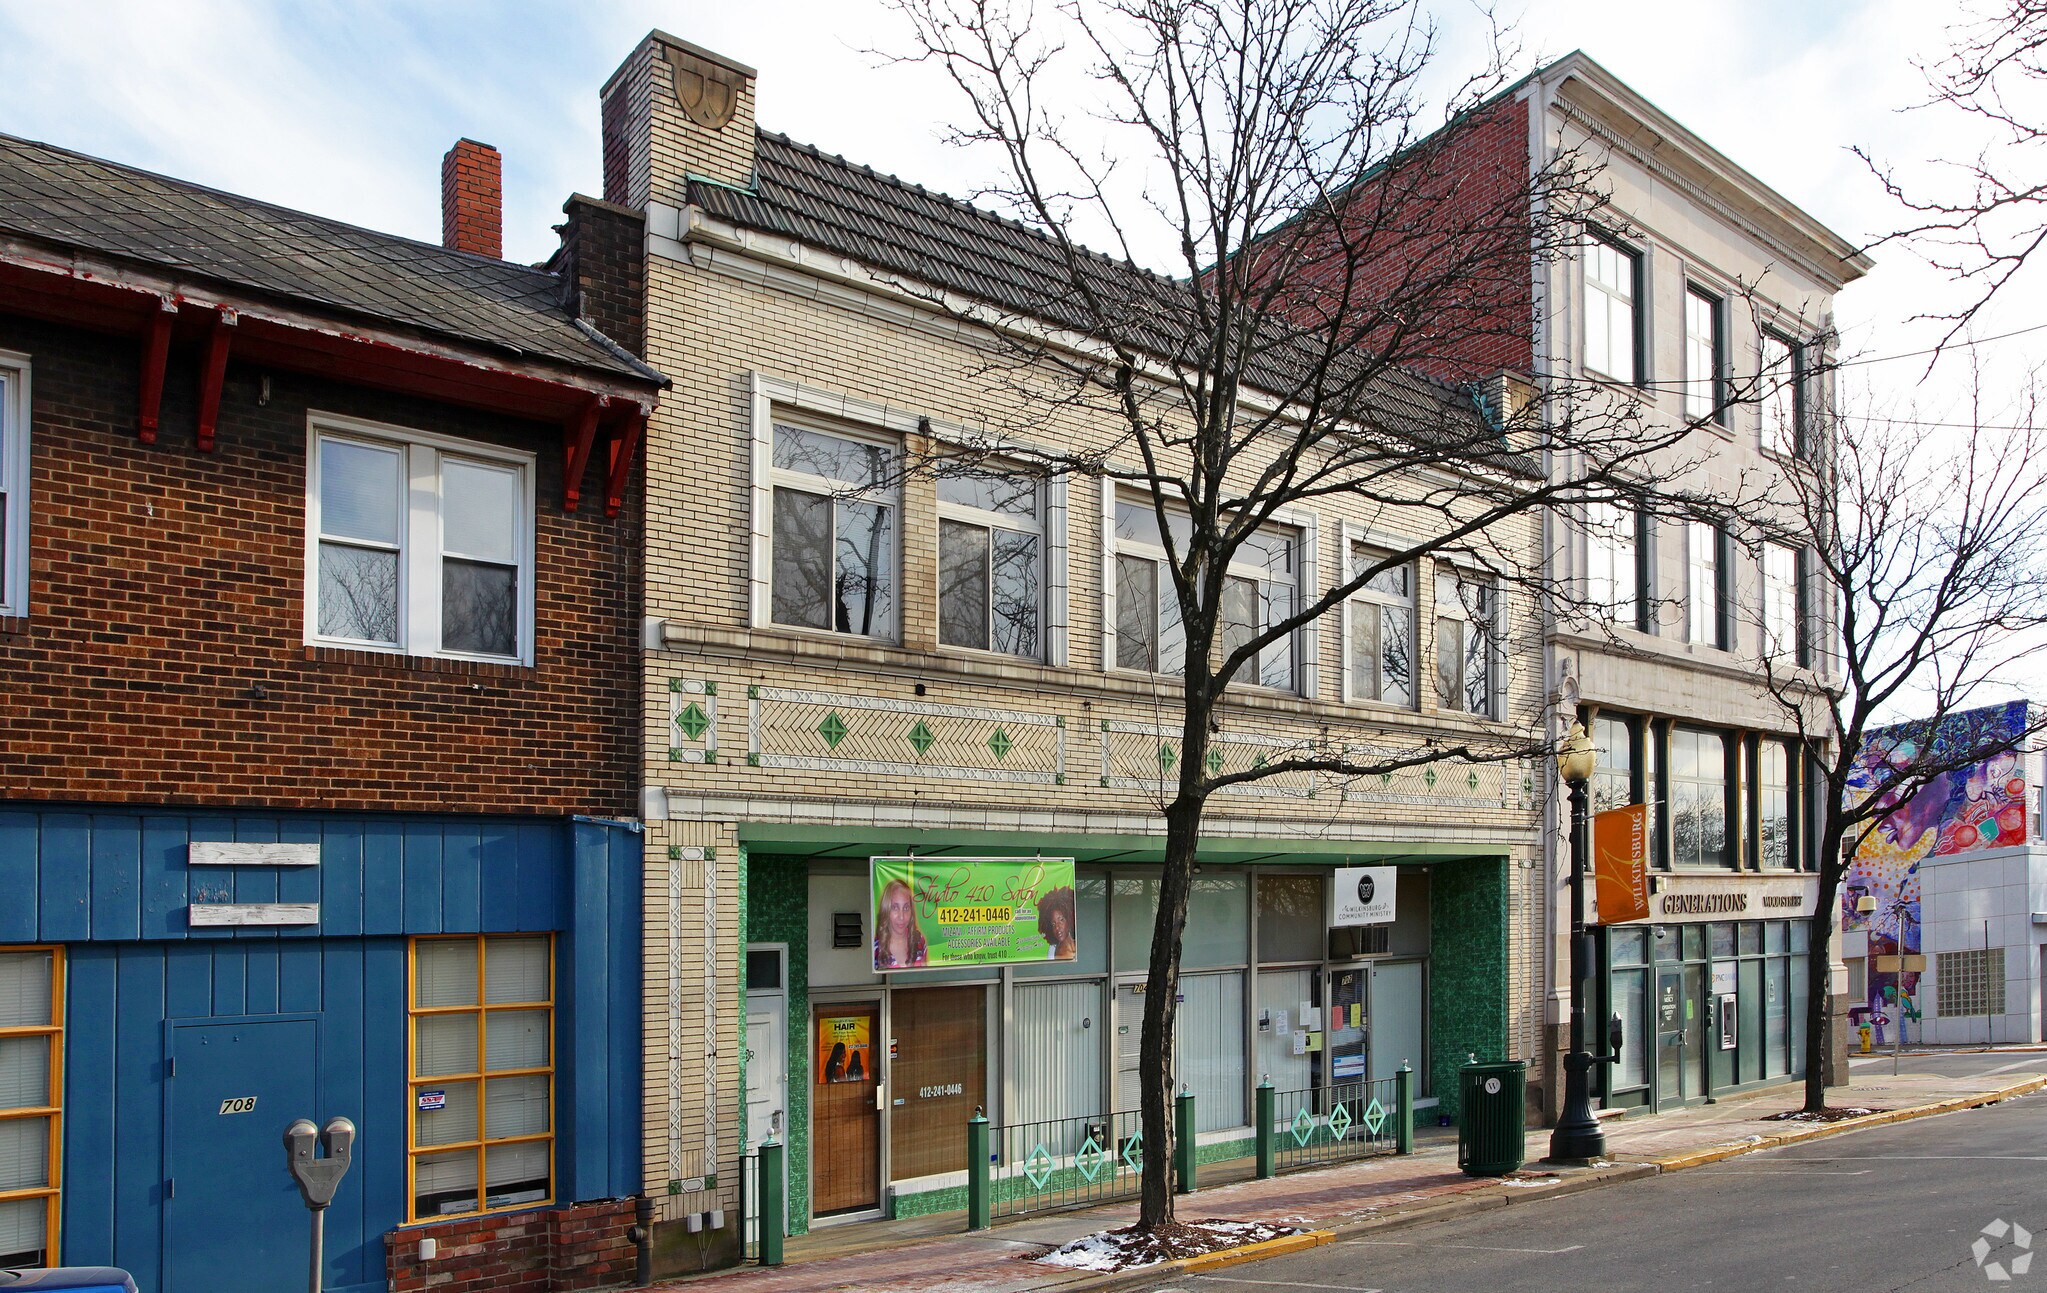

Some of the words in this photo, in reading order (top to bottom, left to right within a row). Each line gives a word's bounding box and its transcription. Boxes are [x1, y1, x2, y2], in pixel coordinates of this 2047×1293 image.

[1631, 812, 1645, 911] WILKINSBURG
[913, 867, 971, 918] Studio
[965, 885, 994, 903] 410
[1001, 866, 1045, 908] Salon
[1349, 904, 1382, 912] WILKINSBURG
[1662, 893, 1748, 914] GENERATIONS
[940, 908, 1010, 922] 412-241-0446
[1339, 911, 1368, 920] COMMUNITY
[967, 925, 987, 936] AFFIRM
[988, 924, 1015, 935] PRODUCTS
[947, 937, 982, 949] ACCESSORIES
[983, 936, 1011, 947] AVAILABLE
[998, 950, 1007, 958] 410
[919, 1083, 962, 1098] 412-241-0446
[222, 1098, 255, 1114] 708
